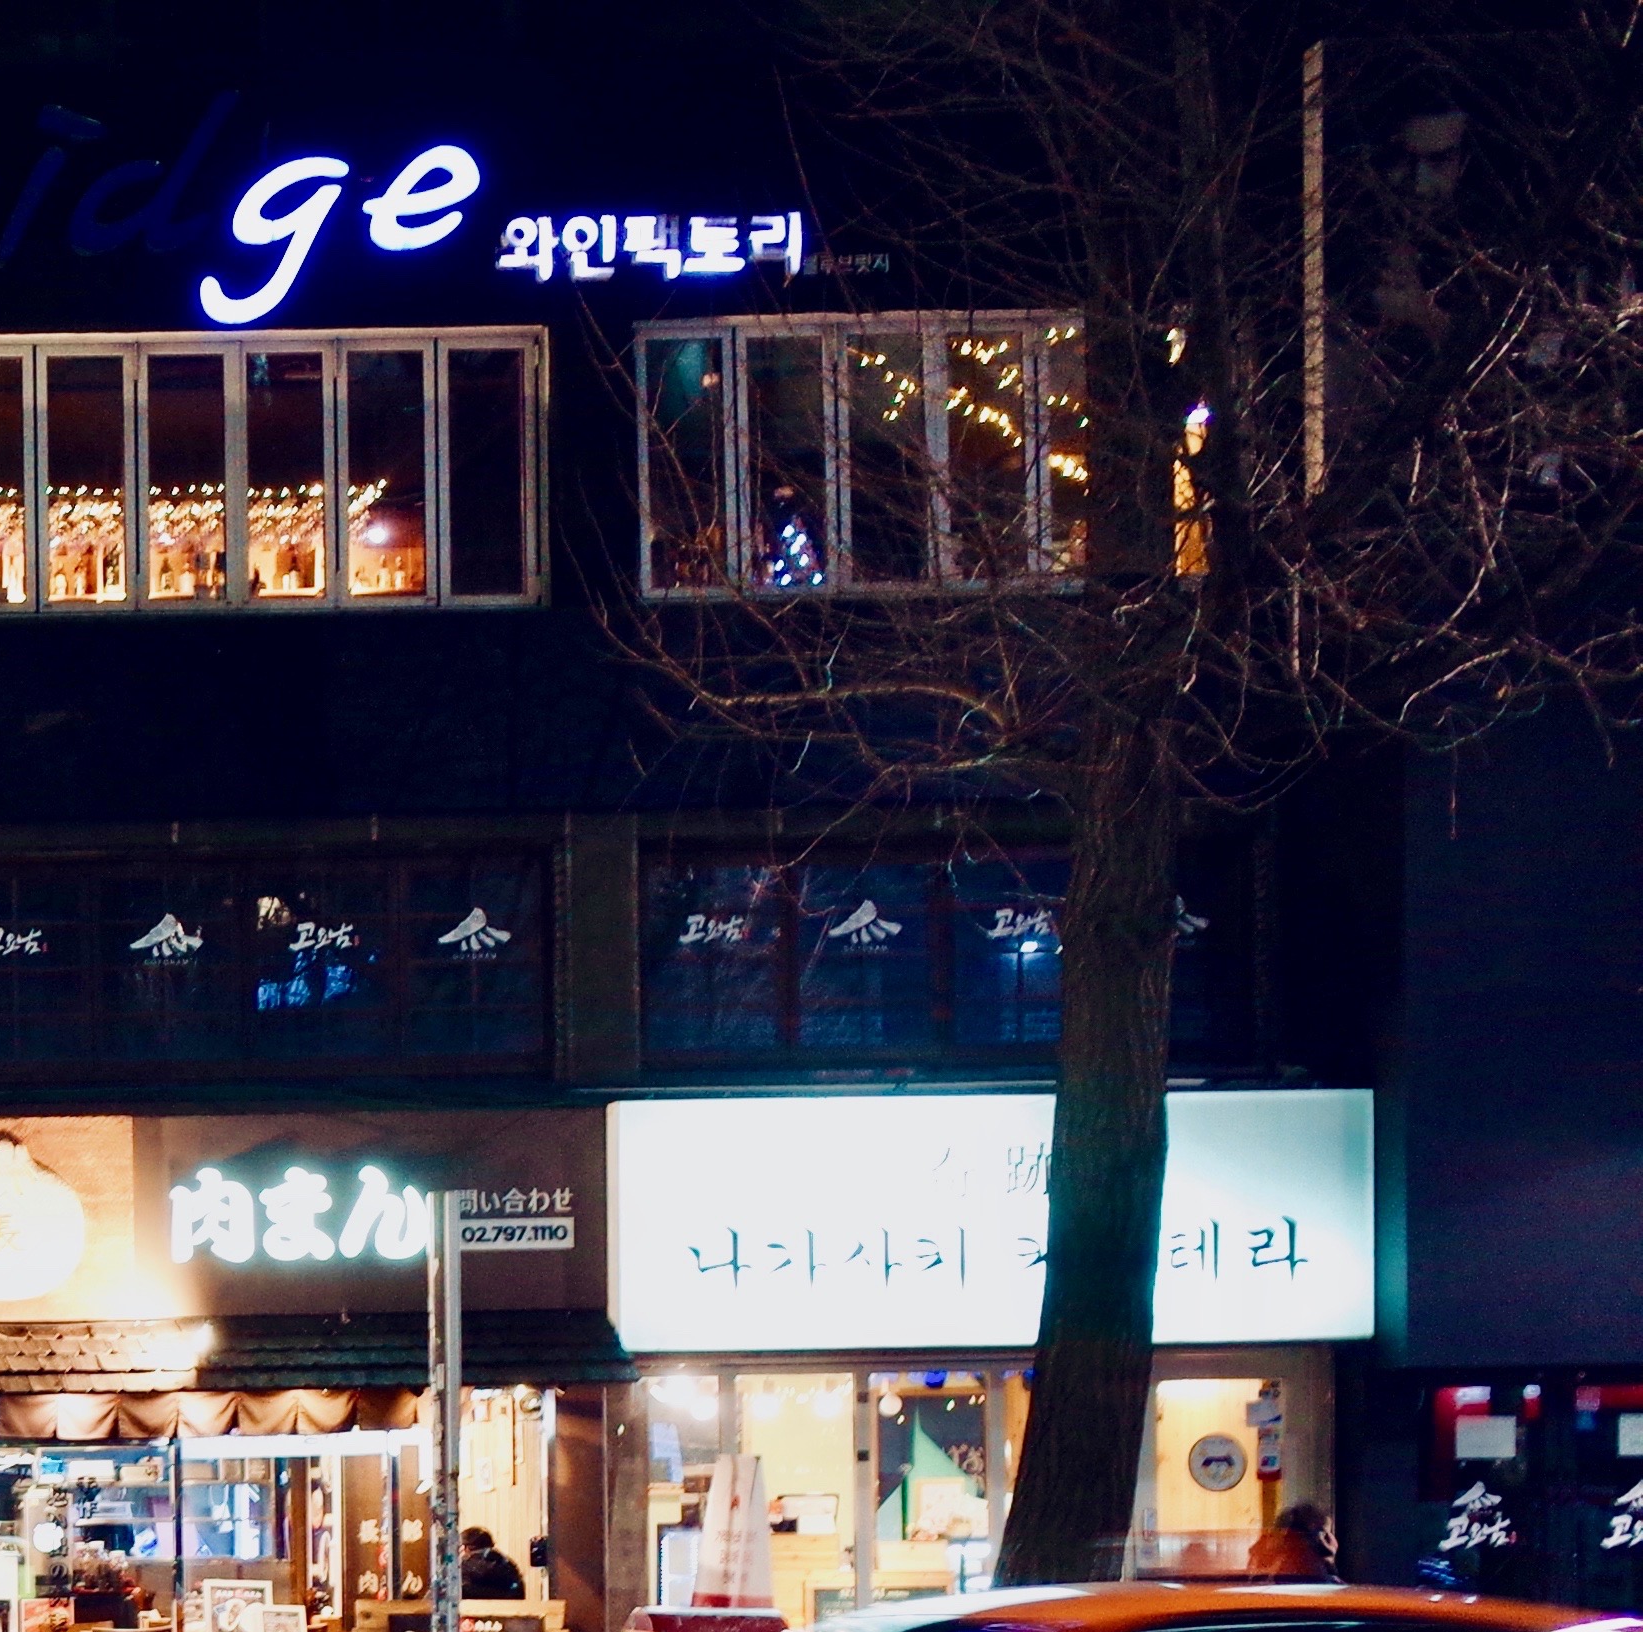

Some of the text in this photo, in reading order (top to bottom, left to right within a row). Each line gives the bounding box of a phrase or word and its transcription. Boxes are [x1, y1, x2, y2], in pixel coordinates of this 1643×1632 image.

[496, 211, 802, 282] 와인팩토리
[168, 1165, 428, 1263] 肉まん
[687, 1225, 969, 1290] 나가사키
